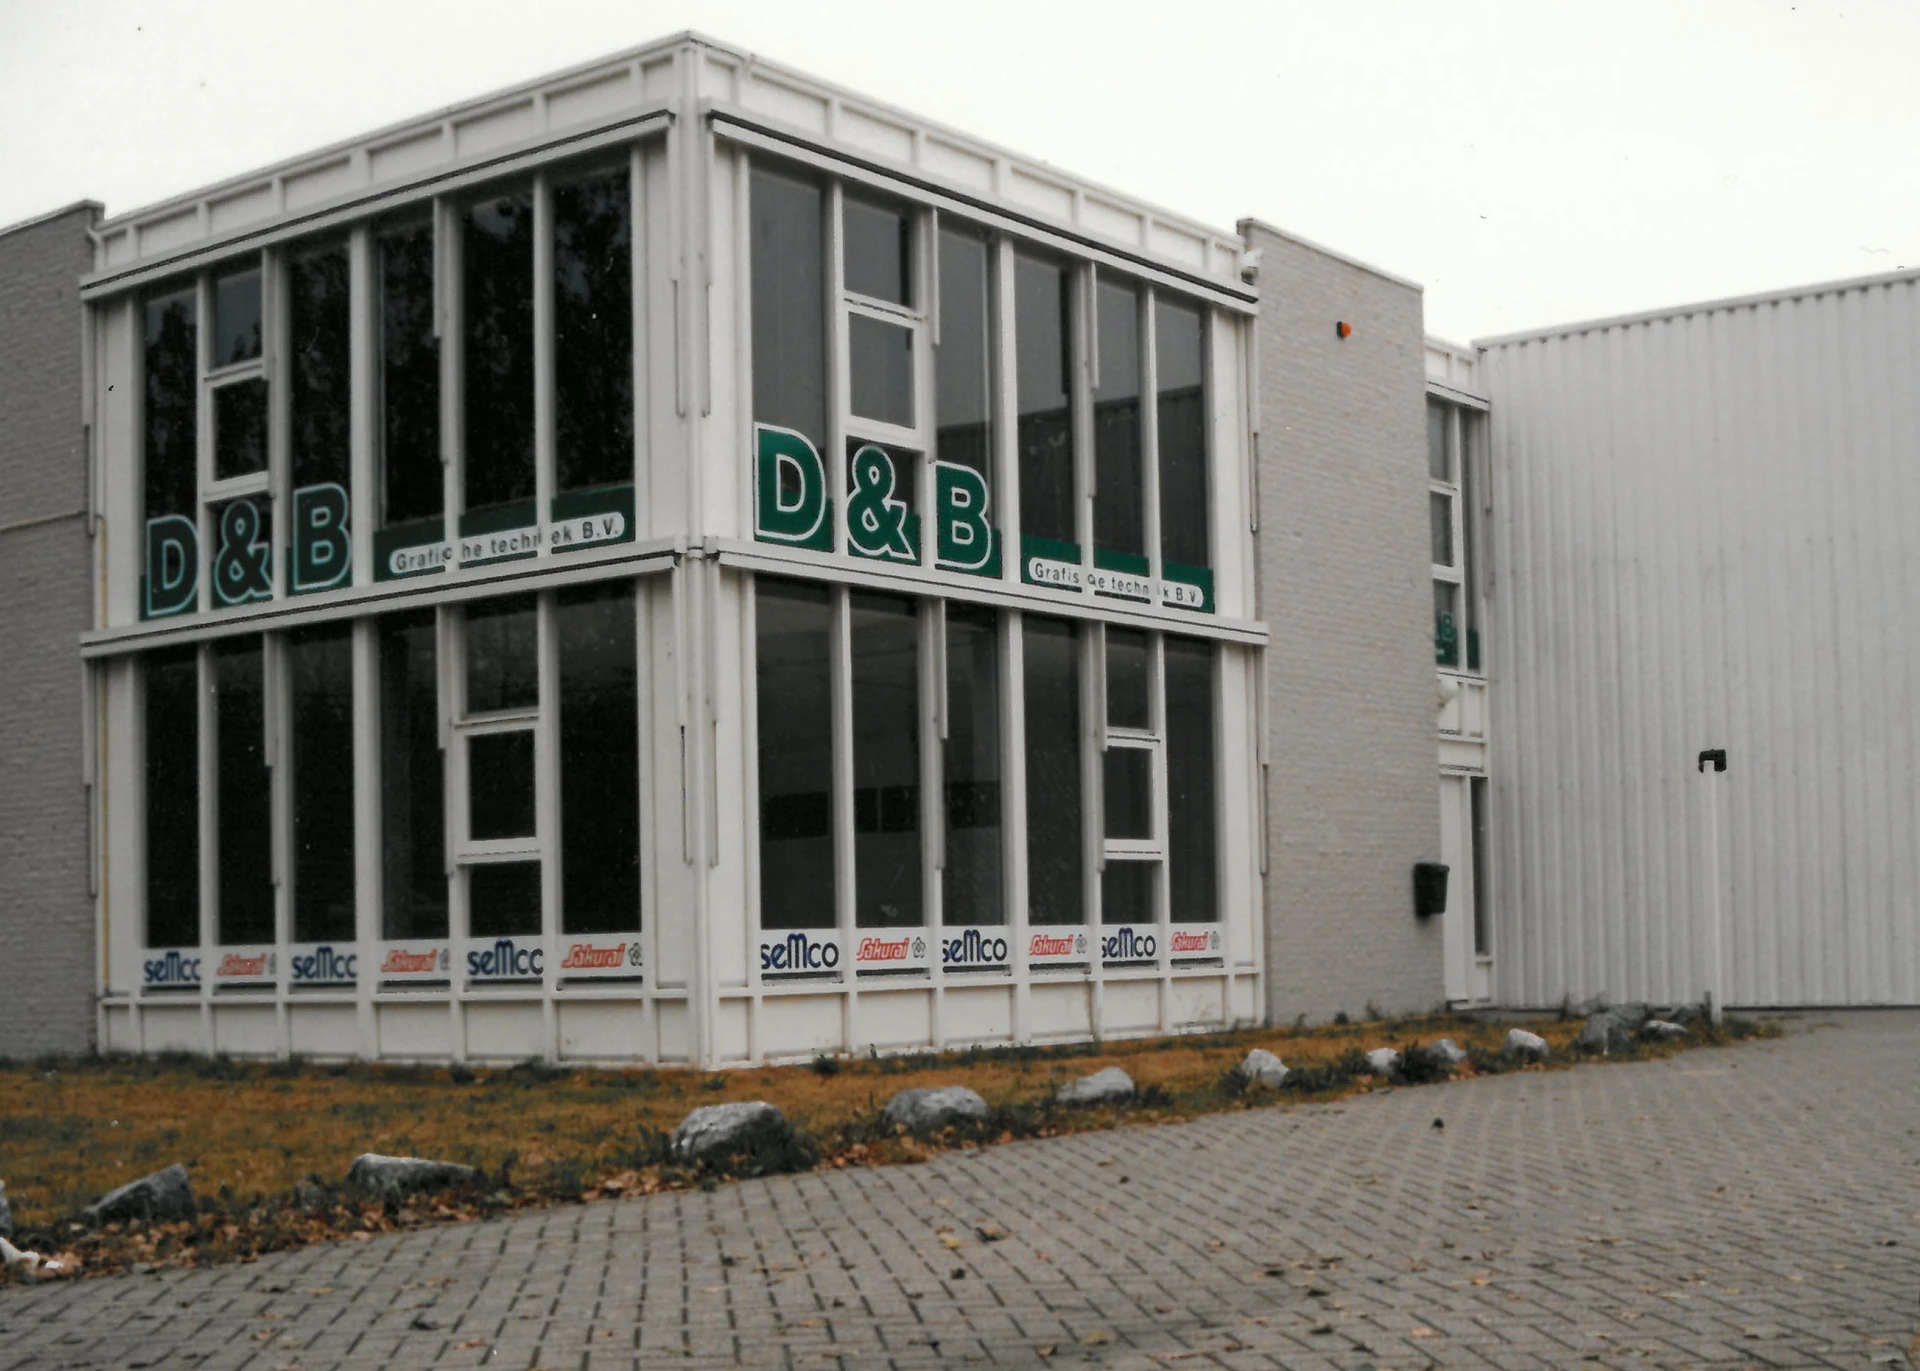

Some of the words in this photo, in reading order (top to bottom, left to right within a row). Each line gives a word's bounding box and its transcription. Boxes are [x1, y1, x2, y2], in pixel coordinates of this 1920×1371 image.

[753, 421, 826, 542] D
[847, 444, 917, 560] &
[934, 460, 992, 570] B
[146, 514, 199, 617] D
[293, 482, 351, 591] B
[396, 543, 483, 570] Grafiche
[856, 937, 911, 961] Sakurai
[1029, 934, 1075, 956] Sakurai
[1170, 931, 1210, 952] Sakurai
[561, 943, 627, 969] Sakurai
